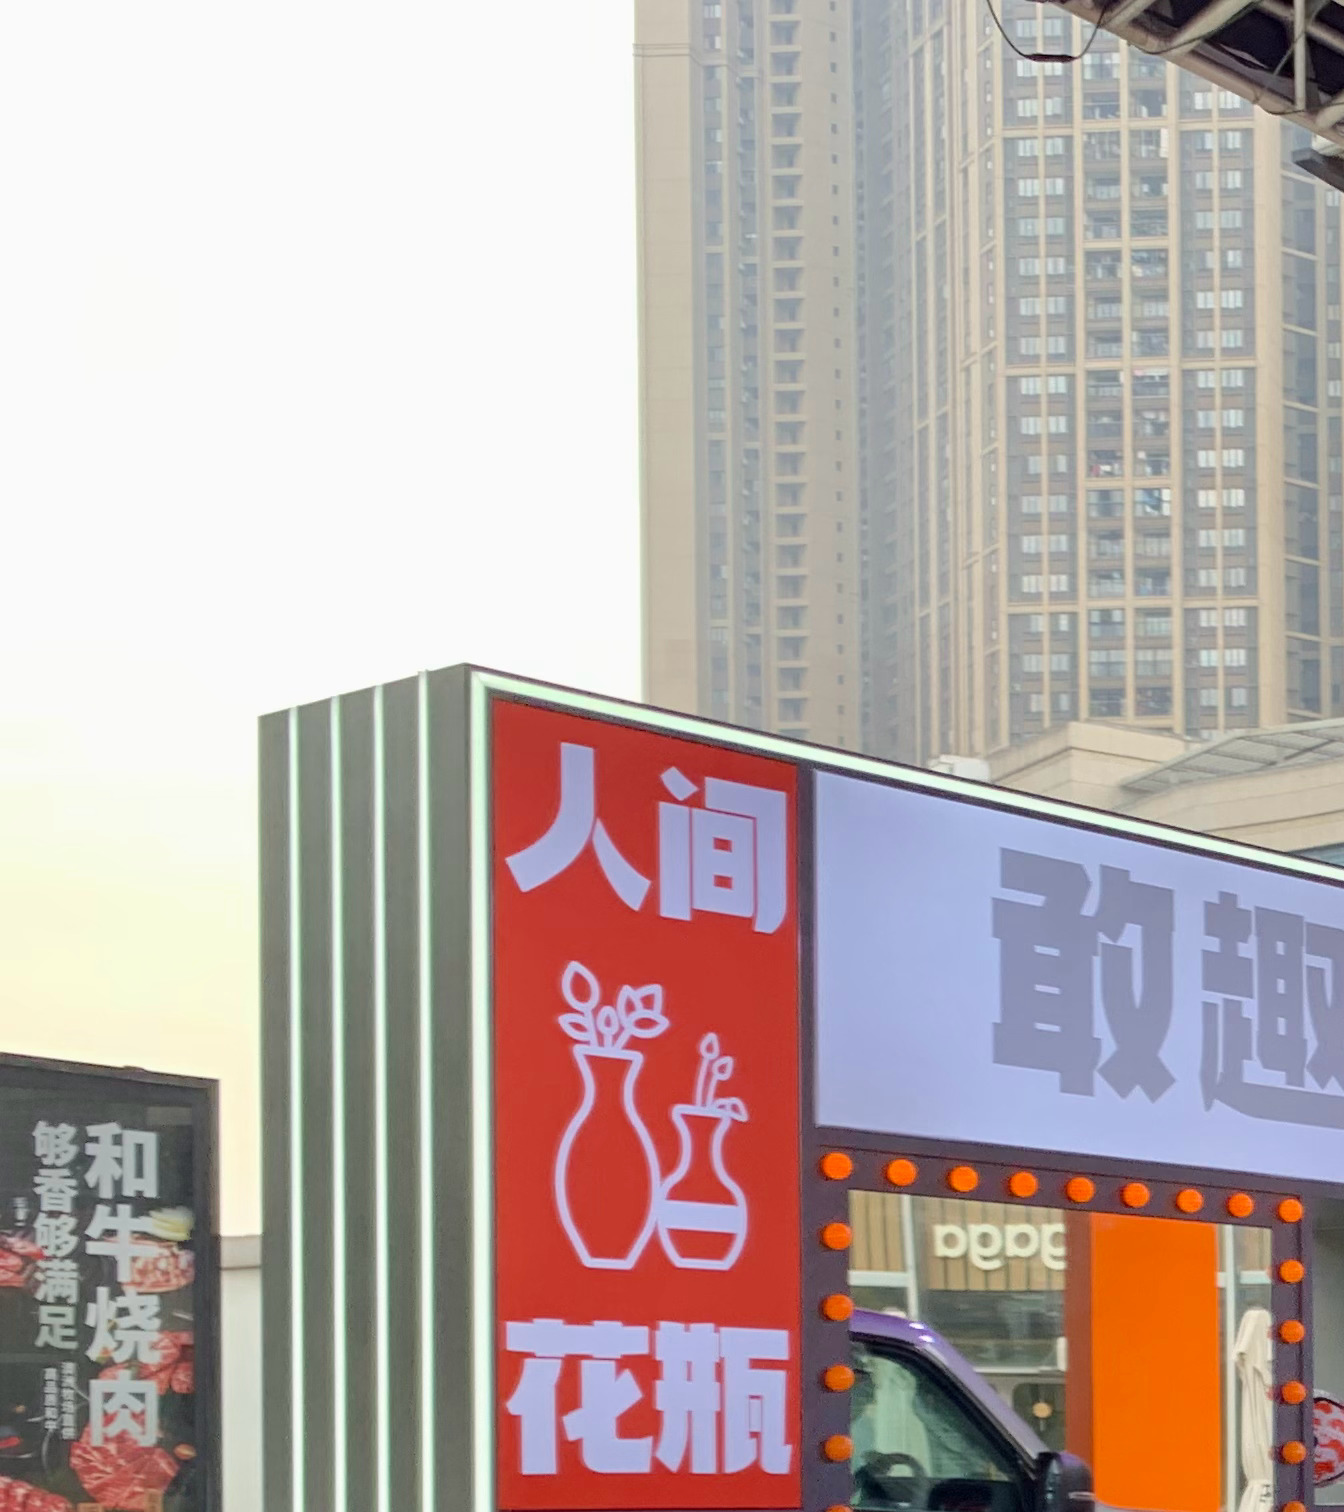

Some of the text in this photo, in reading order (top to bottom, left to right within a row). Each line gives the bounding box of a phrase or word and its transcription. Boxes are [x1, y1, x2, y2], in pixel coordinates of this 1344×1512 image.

[505, 742, 787, 934] 人间
[33, 1120, 79, 1350] 够香够满足
[84, 1122, 162, 1446] 和牛烧肉
[506, 1317, 793, 1475] 花瓶
